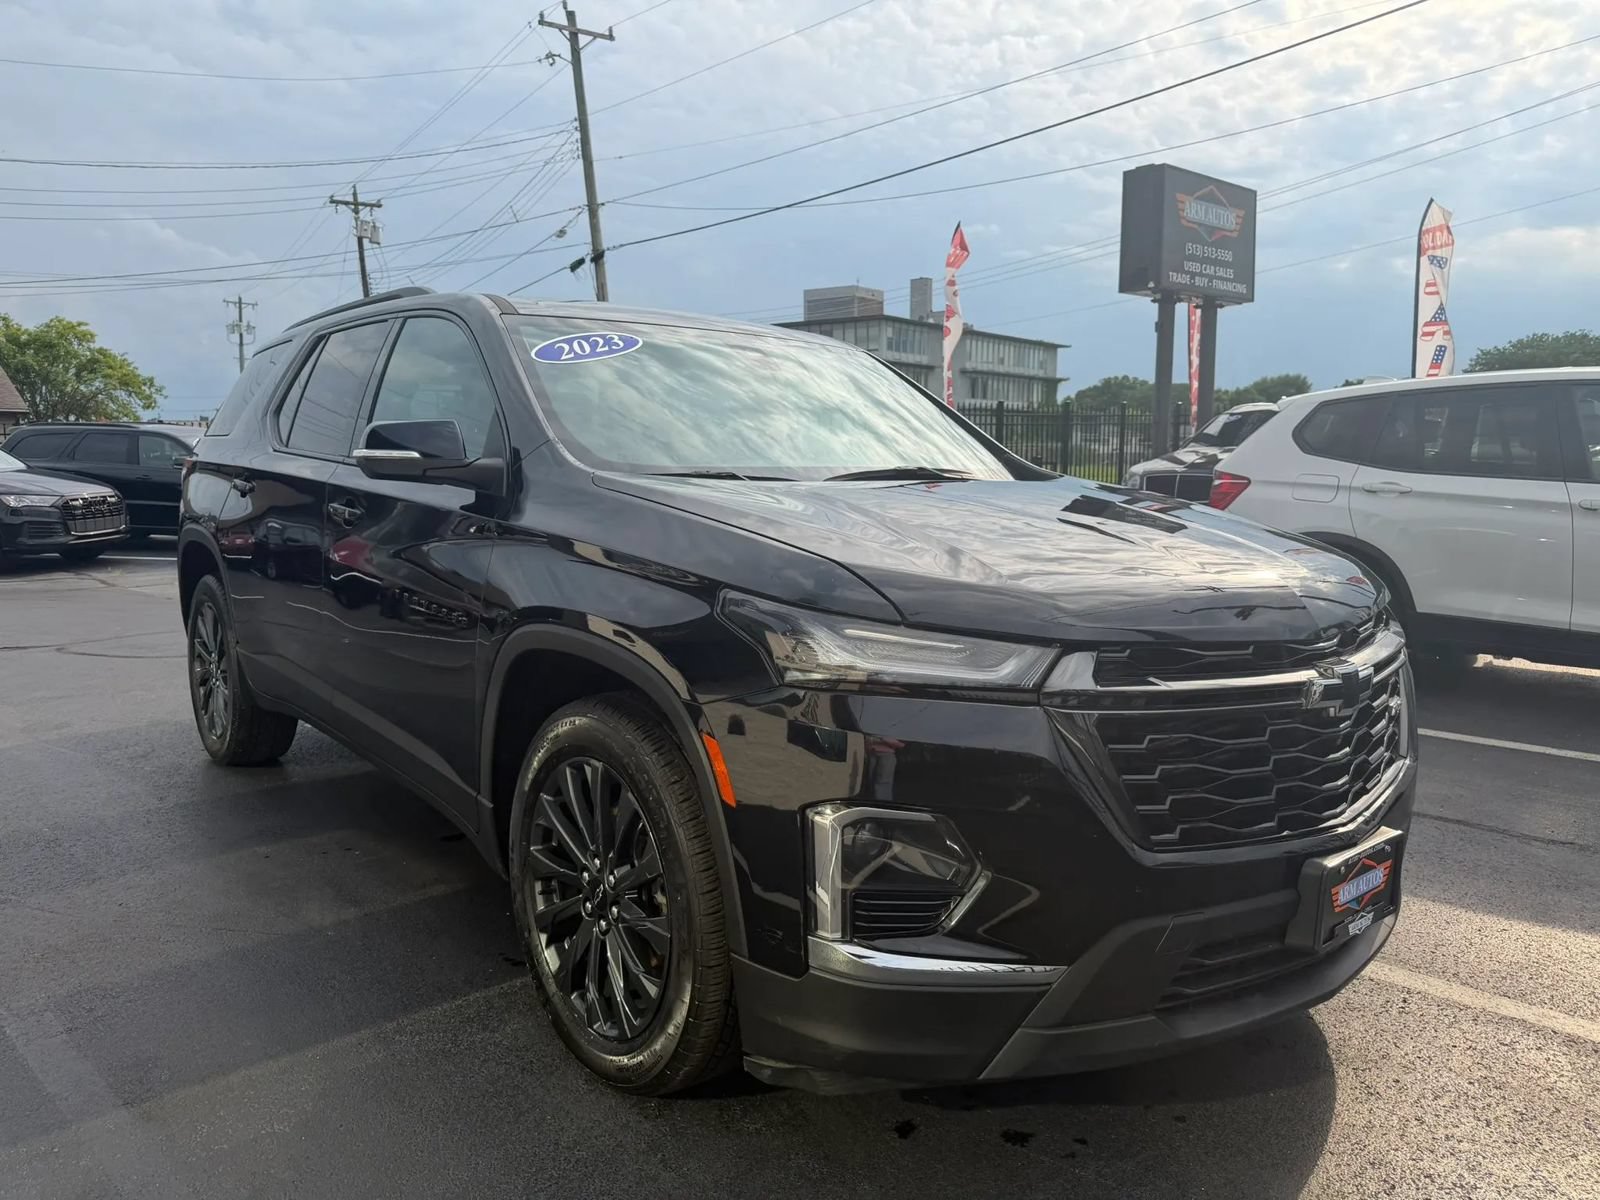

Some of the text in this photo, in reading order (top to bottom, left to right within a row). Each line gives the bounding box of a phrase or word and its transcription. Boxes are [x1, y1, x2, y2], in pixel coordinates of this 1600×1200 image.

[1184, 200, 1236, 228] ARM AUTOS
[1185, 242, 1203, 258] (513)
[1184, 260, 1235, 279] USED CAR SALES
[1168, 271, 1247, 294] TRADE BUY FINANCING
[554, 334, 625, 360] 2023
[1339, 868, 1384, 903] ARM AUTOS
